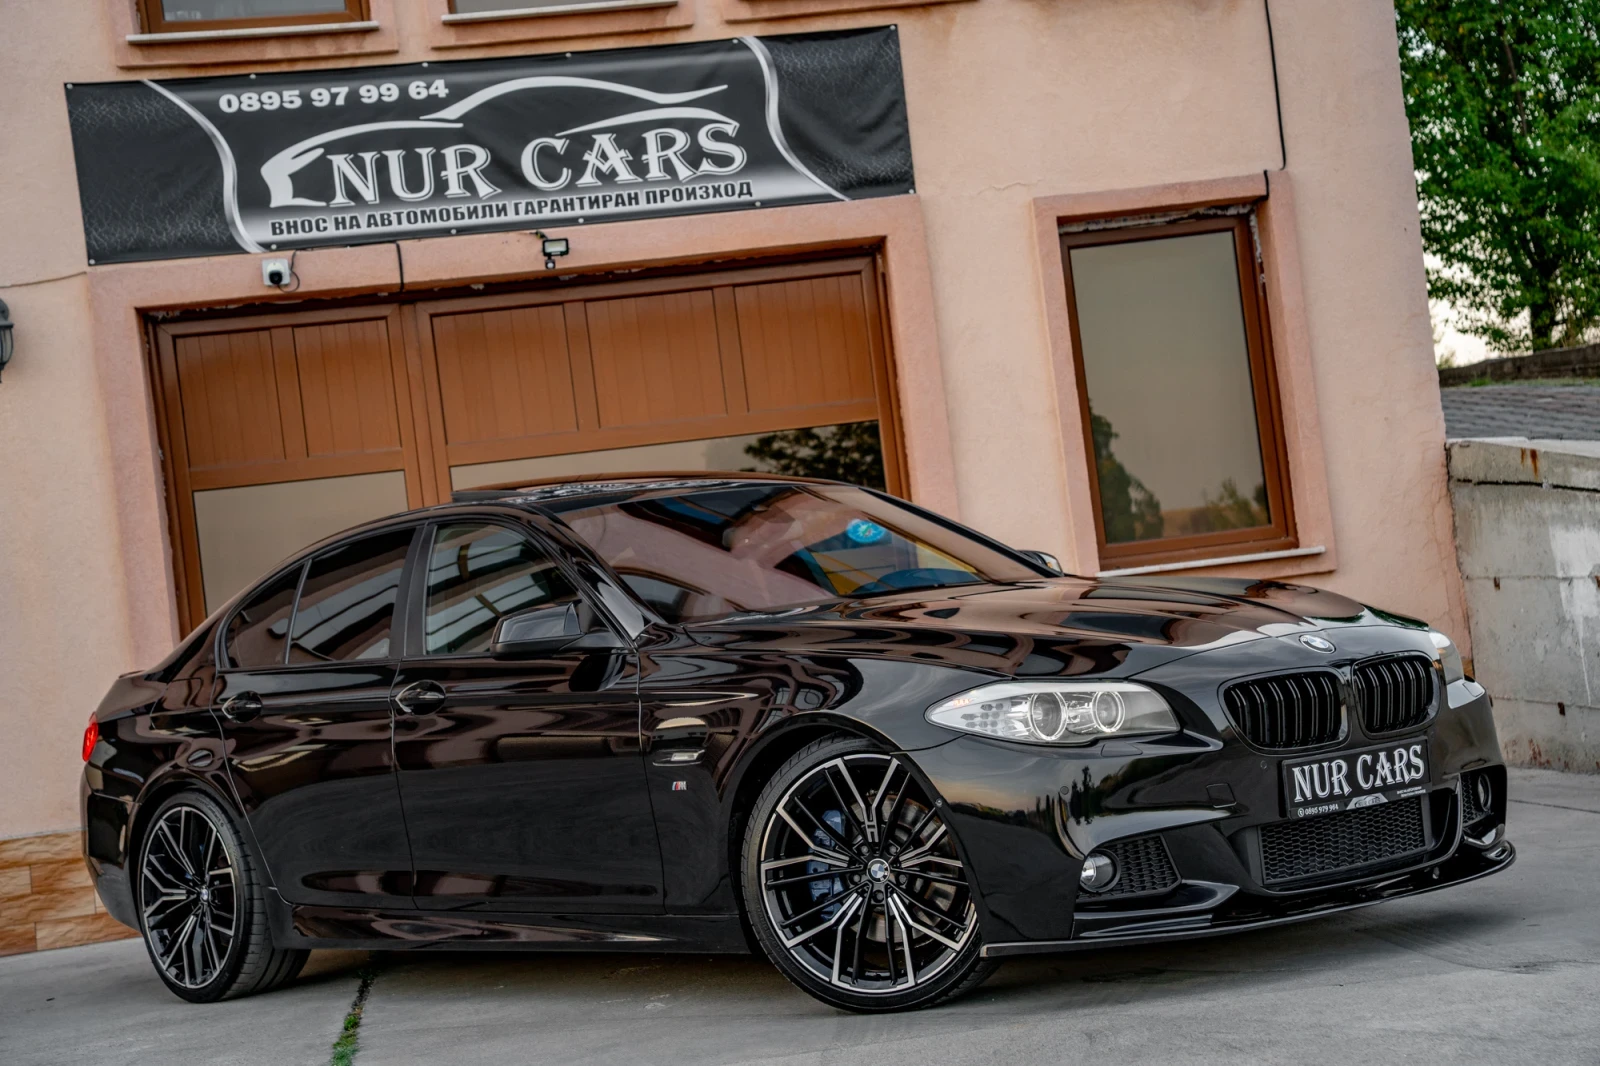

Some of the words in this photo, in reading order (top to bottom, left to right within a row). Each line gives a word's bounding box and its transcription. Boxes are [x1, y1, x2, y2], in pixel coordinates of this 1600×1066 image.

[218, 88, 302, 113] 0895
[310, 86, 350, 108] 97
[359, 82, 400, 104] 99
[408, 78, 449, 99] 64
[326, 143, 503, 207] NUR
[521, 122, 747, 191] CARS
[269, 216, 328, 236] ВНОС
[333, 212, 362, 231] НА
[366, 199, 508, 228] АВТОМОБИЛИ
[513, 191, 640, 217] ГАРАНТИРАН
[645, 180, 753, 205] ПРОИЗХОД
[1292, 758, 1352, 803] NUR
[1356, 744, 1425, 790] CARS
[1318, 805, 1329, 814] 979
